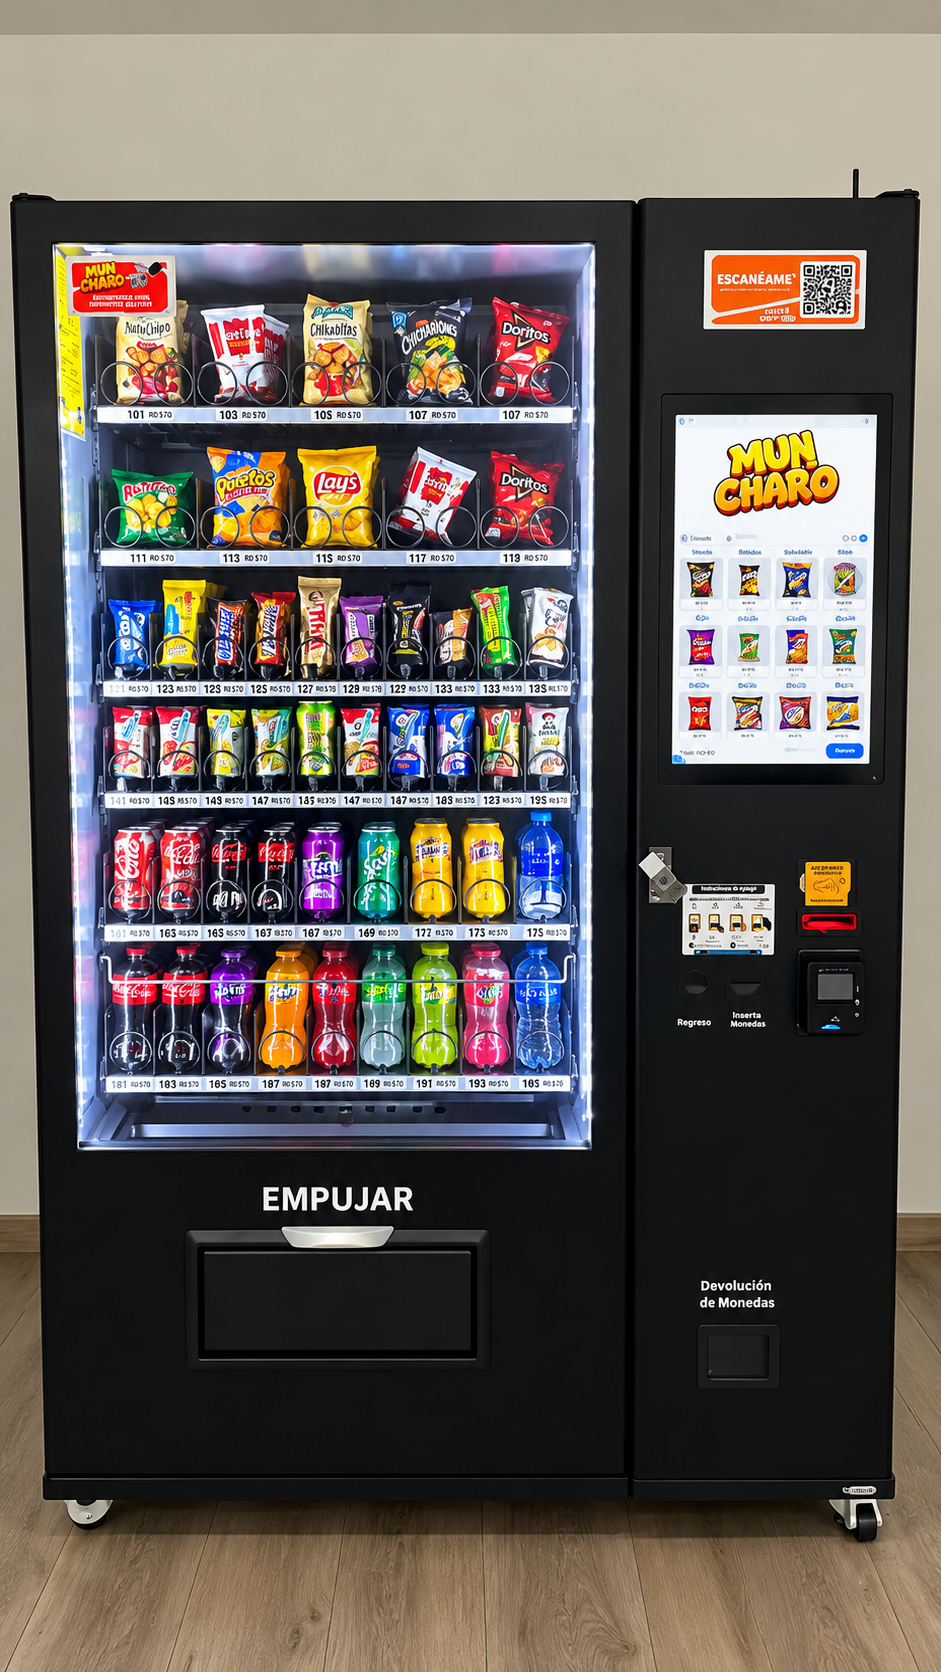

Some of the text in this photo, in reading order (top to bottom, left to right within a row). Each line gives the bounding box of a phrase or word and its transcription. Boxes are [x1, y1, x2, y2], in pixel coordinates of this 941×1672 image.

[85, 261, 116, 279] MUN
[80, 273, 125, 293] CHARO
[502, 321, 551, 345] Doritos
[128, 410, 144, 420] 101
[219, 410, 238, 420] 103
[409, 410, 428, 420] 107
[503, 410, 521, 420] 107
[726, 429, 819, 475] MUN
[500, 472, 549, 494] Doritos
[714, 463, 841, 517] CHARO
[130, 553, 146, 563] 111
[223, 553, 240, 563] 113
[409, 553, 427, 563] 117
[157, 684, 175, 694] 123
[297, 684, 314, 694] 127
[483, 684, 501, 694] 133
[732, 1011, 762, 1019] Inserta
[677, 1018, 712, 1028] Regreso
[730, 1020, 767, 1028] Monedas
[468, 1079, 487, 1089] 193
[262, 1186, 415, 1211] EMPUJAR
[700, 1279, 772, 1291] Devolución
[699, 1296, 776, 1308] de Monedas
